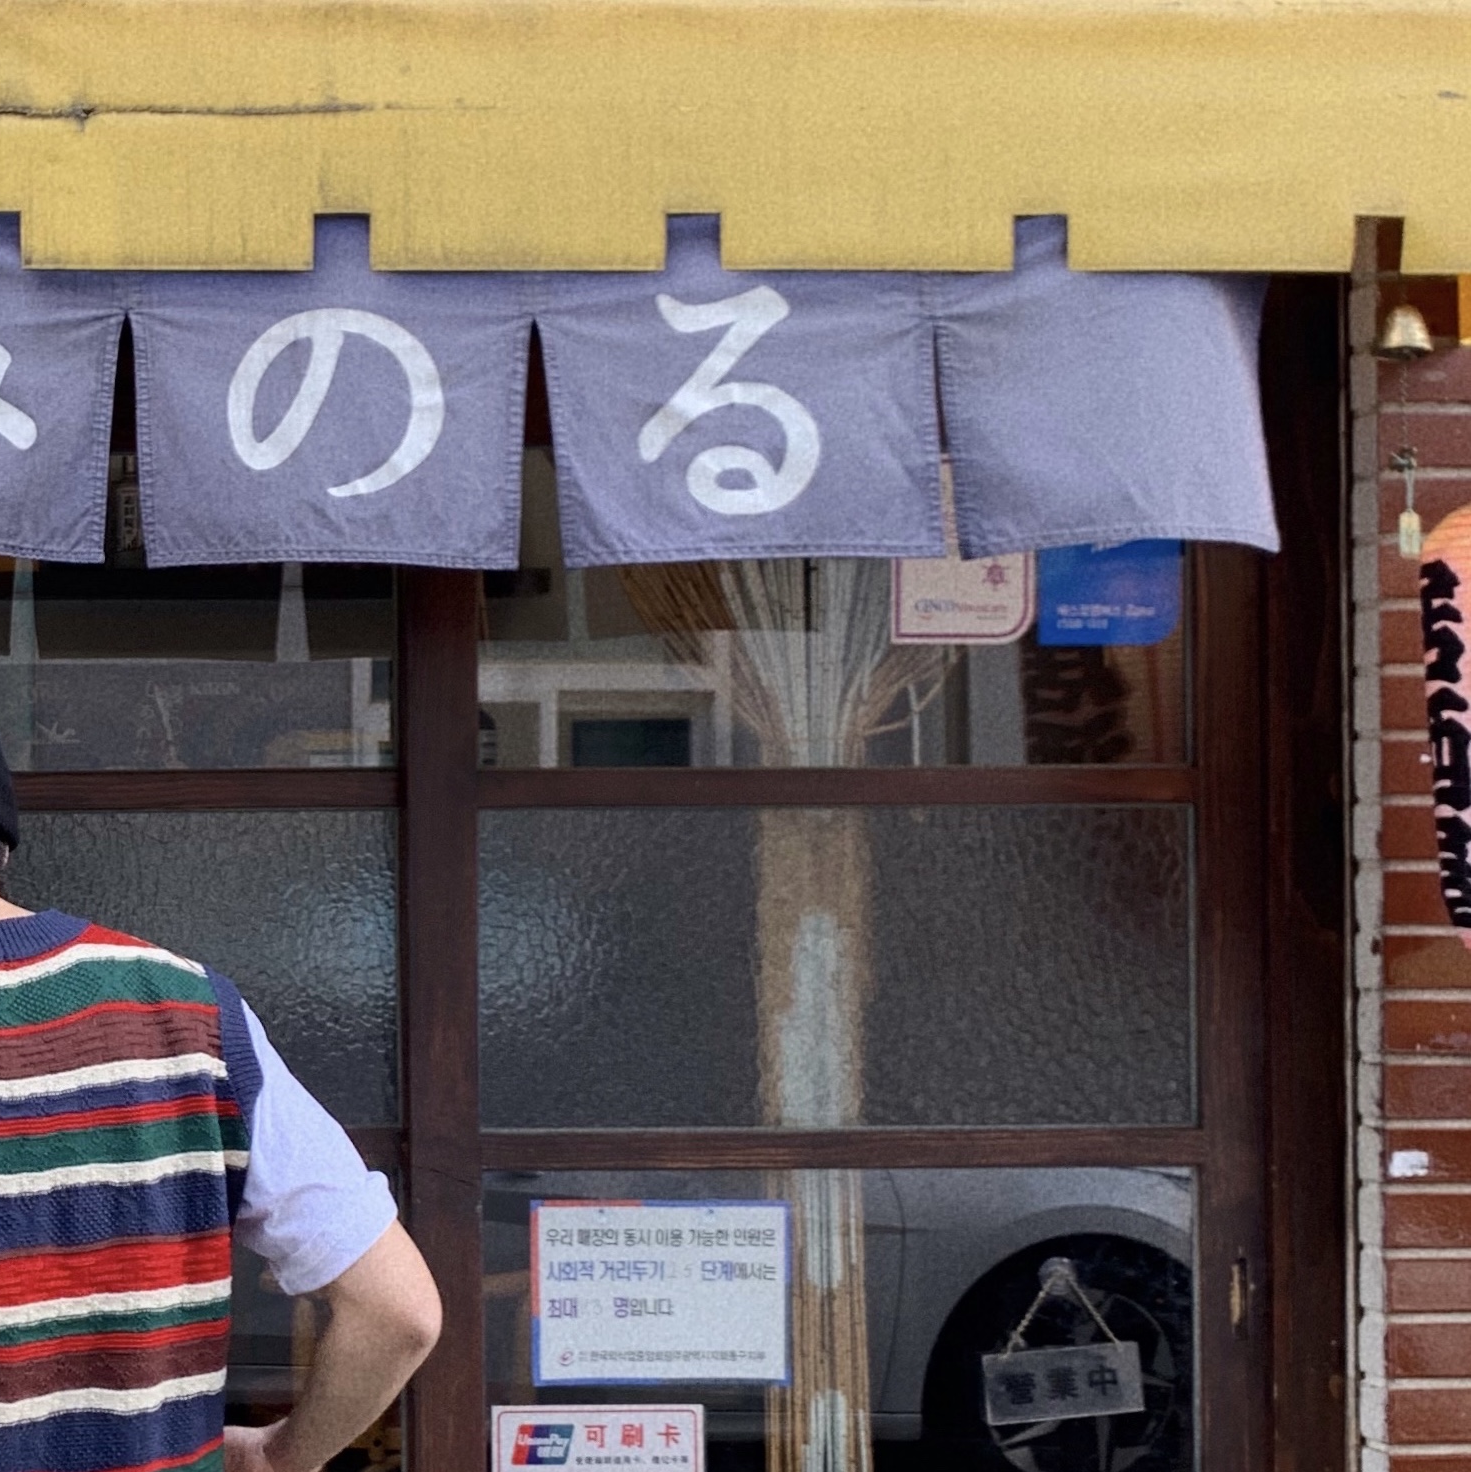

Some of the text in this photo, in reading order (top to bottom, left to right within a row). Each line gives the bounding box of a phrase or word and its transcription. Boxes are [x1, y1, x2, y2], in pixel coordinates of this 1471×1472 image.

[546, 1228, 573, 1247] 우리
[624, 1228, 651, 1247] 동시
[656, 1229, 683, 1247] 이용
[689, 1228, 729, 1247] 가능한
[734, 1228, 776, 1247] 인원은
[546, 1260, 594, 1281] 사회적
[600, 1260, 665, 1281] 거리두기
[700, 1260, 776, 1281] 단계에서는
[547, 1297, 577, 1319] 최대
[584, 1422, 682, 1449] 可刷卡
